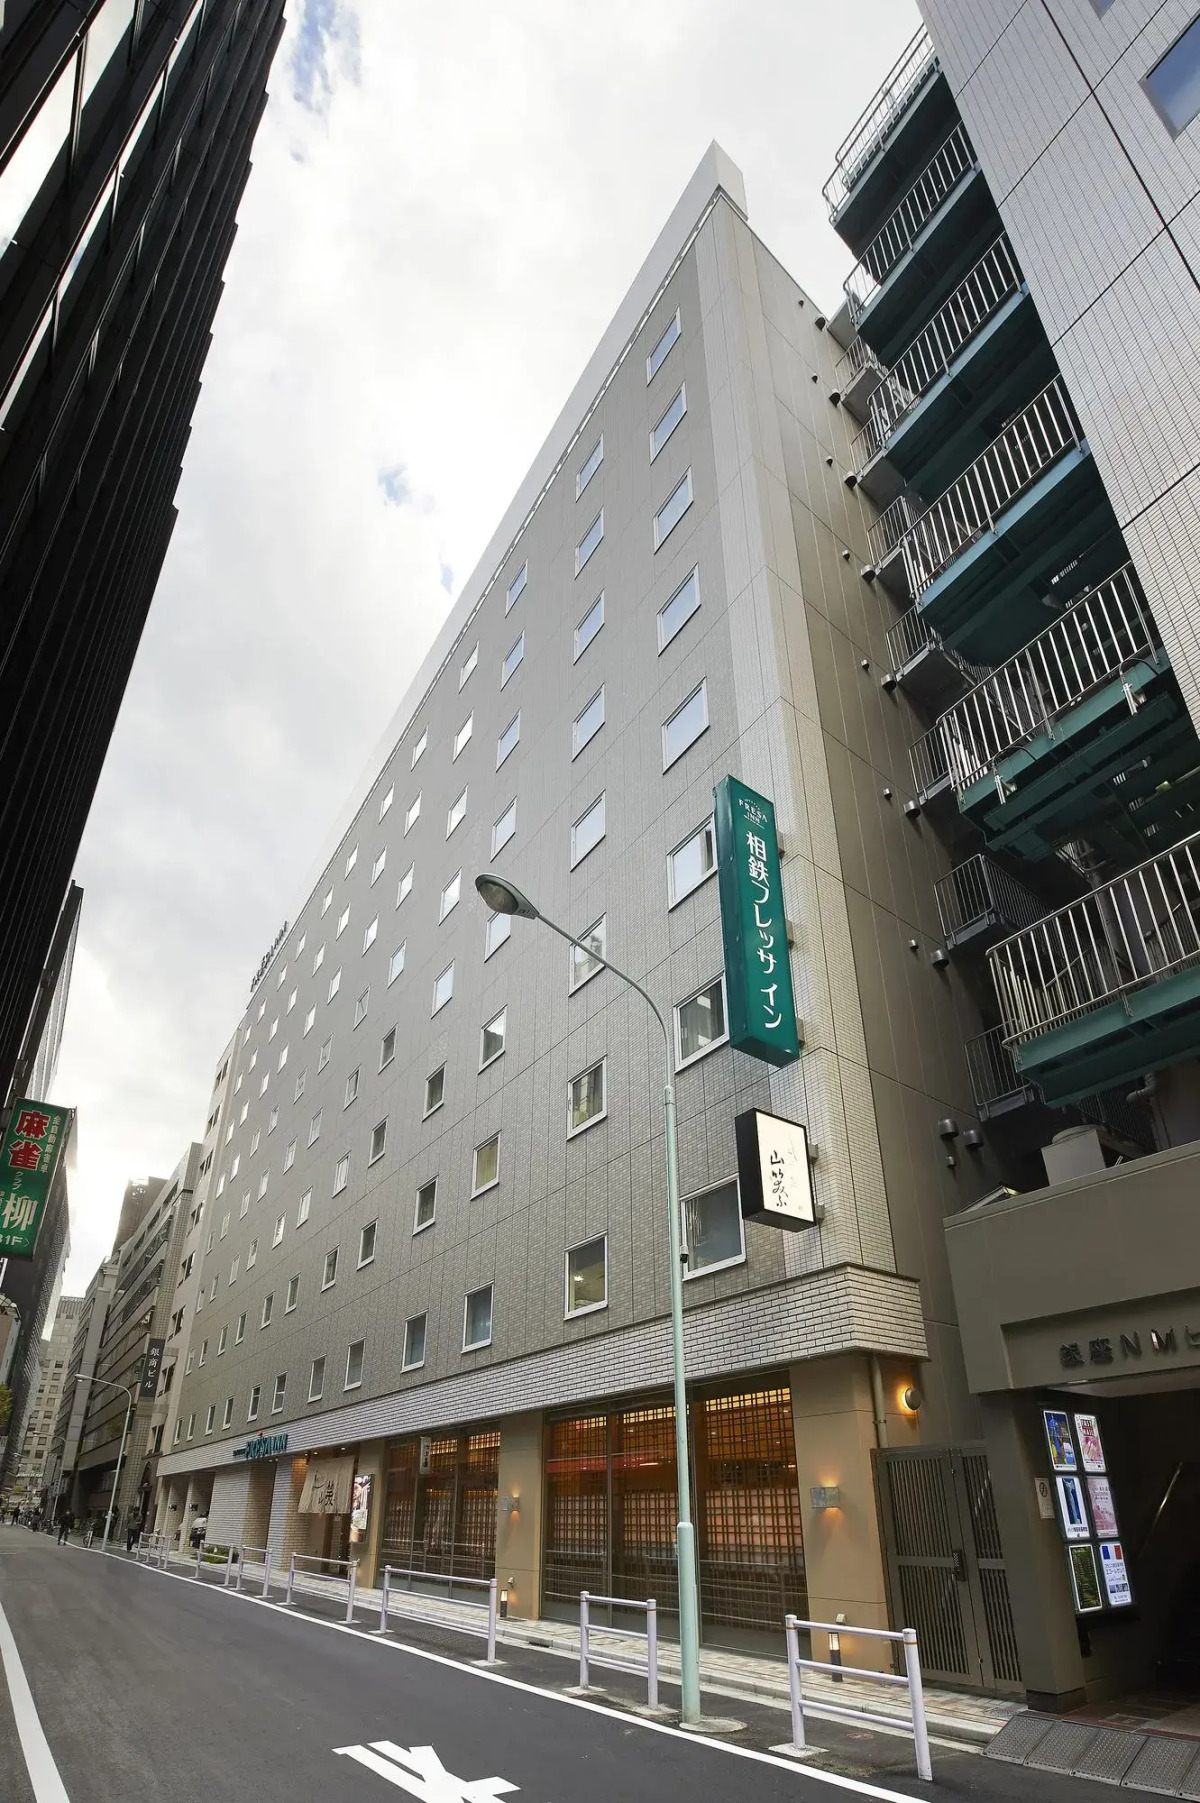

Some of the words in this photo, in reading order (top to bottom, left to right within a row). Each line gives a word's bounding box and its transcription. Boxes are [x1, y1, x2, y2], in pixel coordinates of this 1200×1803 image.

[738, 799, 768, 823] FRESA
[747, 812, 761, 824] INN
[746, 830, 783, 1030] 相鉄フレッサイン
[8, 1109, 52, 1171] 麻雀
[2, 1192, 39, 1231] 柳
